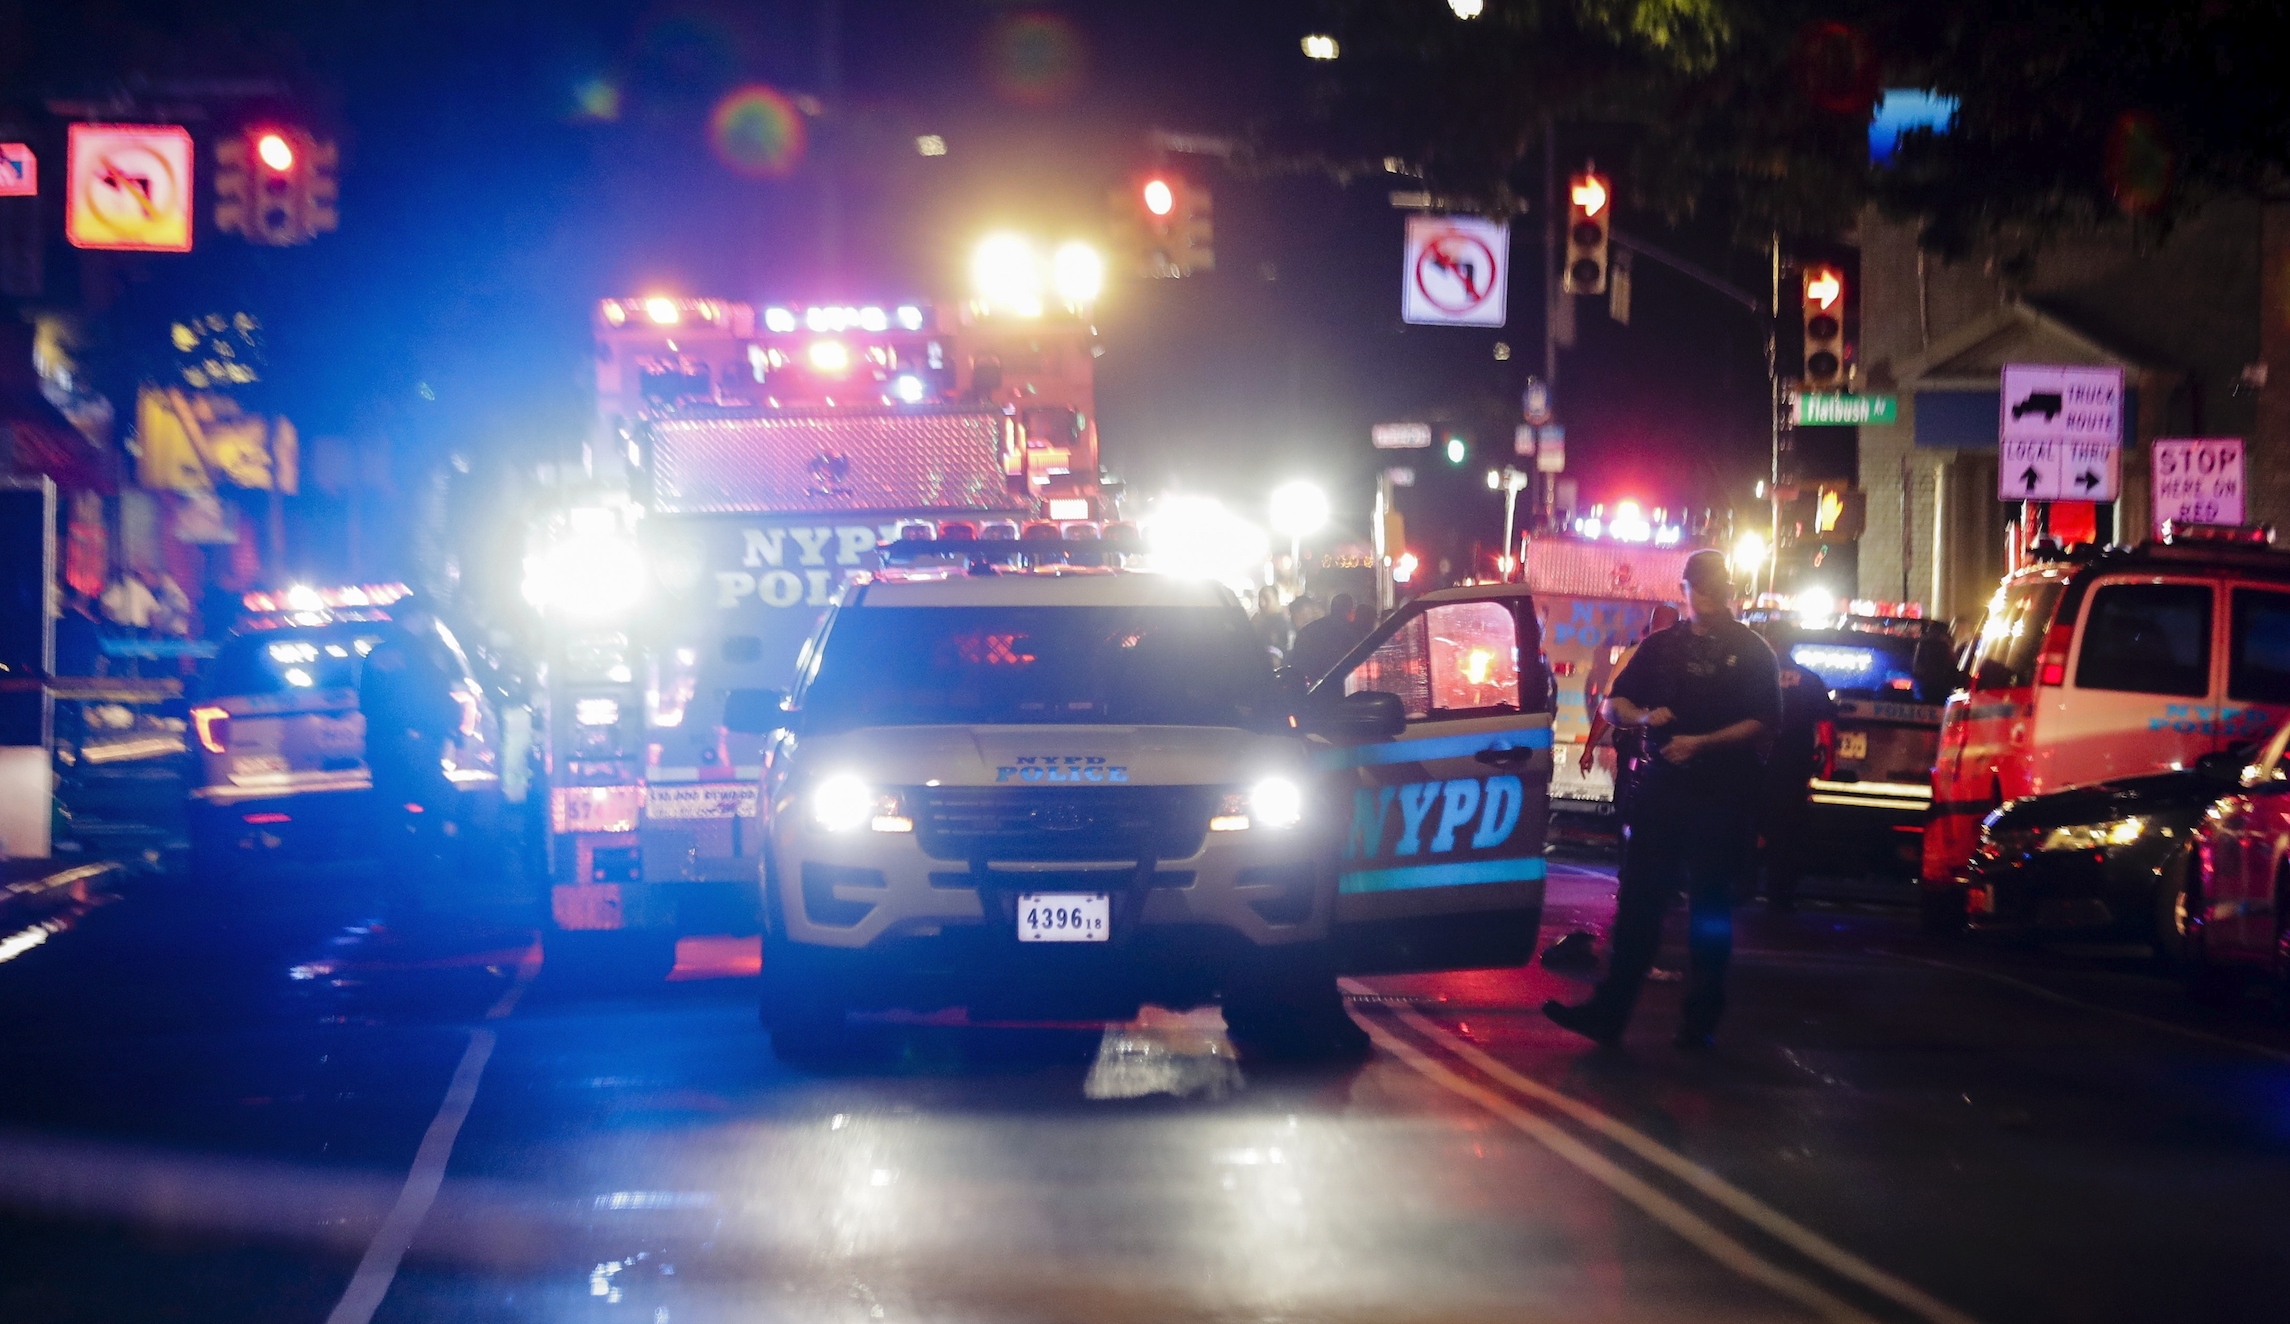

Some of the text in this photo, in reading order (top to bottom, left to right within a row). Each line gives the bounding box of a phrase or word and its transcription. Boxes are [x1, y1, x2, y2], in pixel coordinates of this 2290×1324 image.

[2067, 385, 2114, 404] TRUCK
[1807, 394, 1870, 422] Flatbush
[2066, 412, 2112, 432] ROUTE
[2007, 440, 2054, 461] LOCAL
[2070, 441, 2111, 462] THRU
[2160, 448, 2237, 475] STOP
[2160, 479, 2238, 499] HERE ON
[2179, 501, 2219, 522] RED
[1572, 601, 1650, 627] NYP
[2166, 703, 2268, 722] NYPD
[1016, 756, 1106, 765] NYPD
[996, 766, 1130, 782] POLICE
[1342, 774, 1523, 859] NYPD
[1026, 907, 1102, 930] 4396 18
